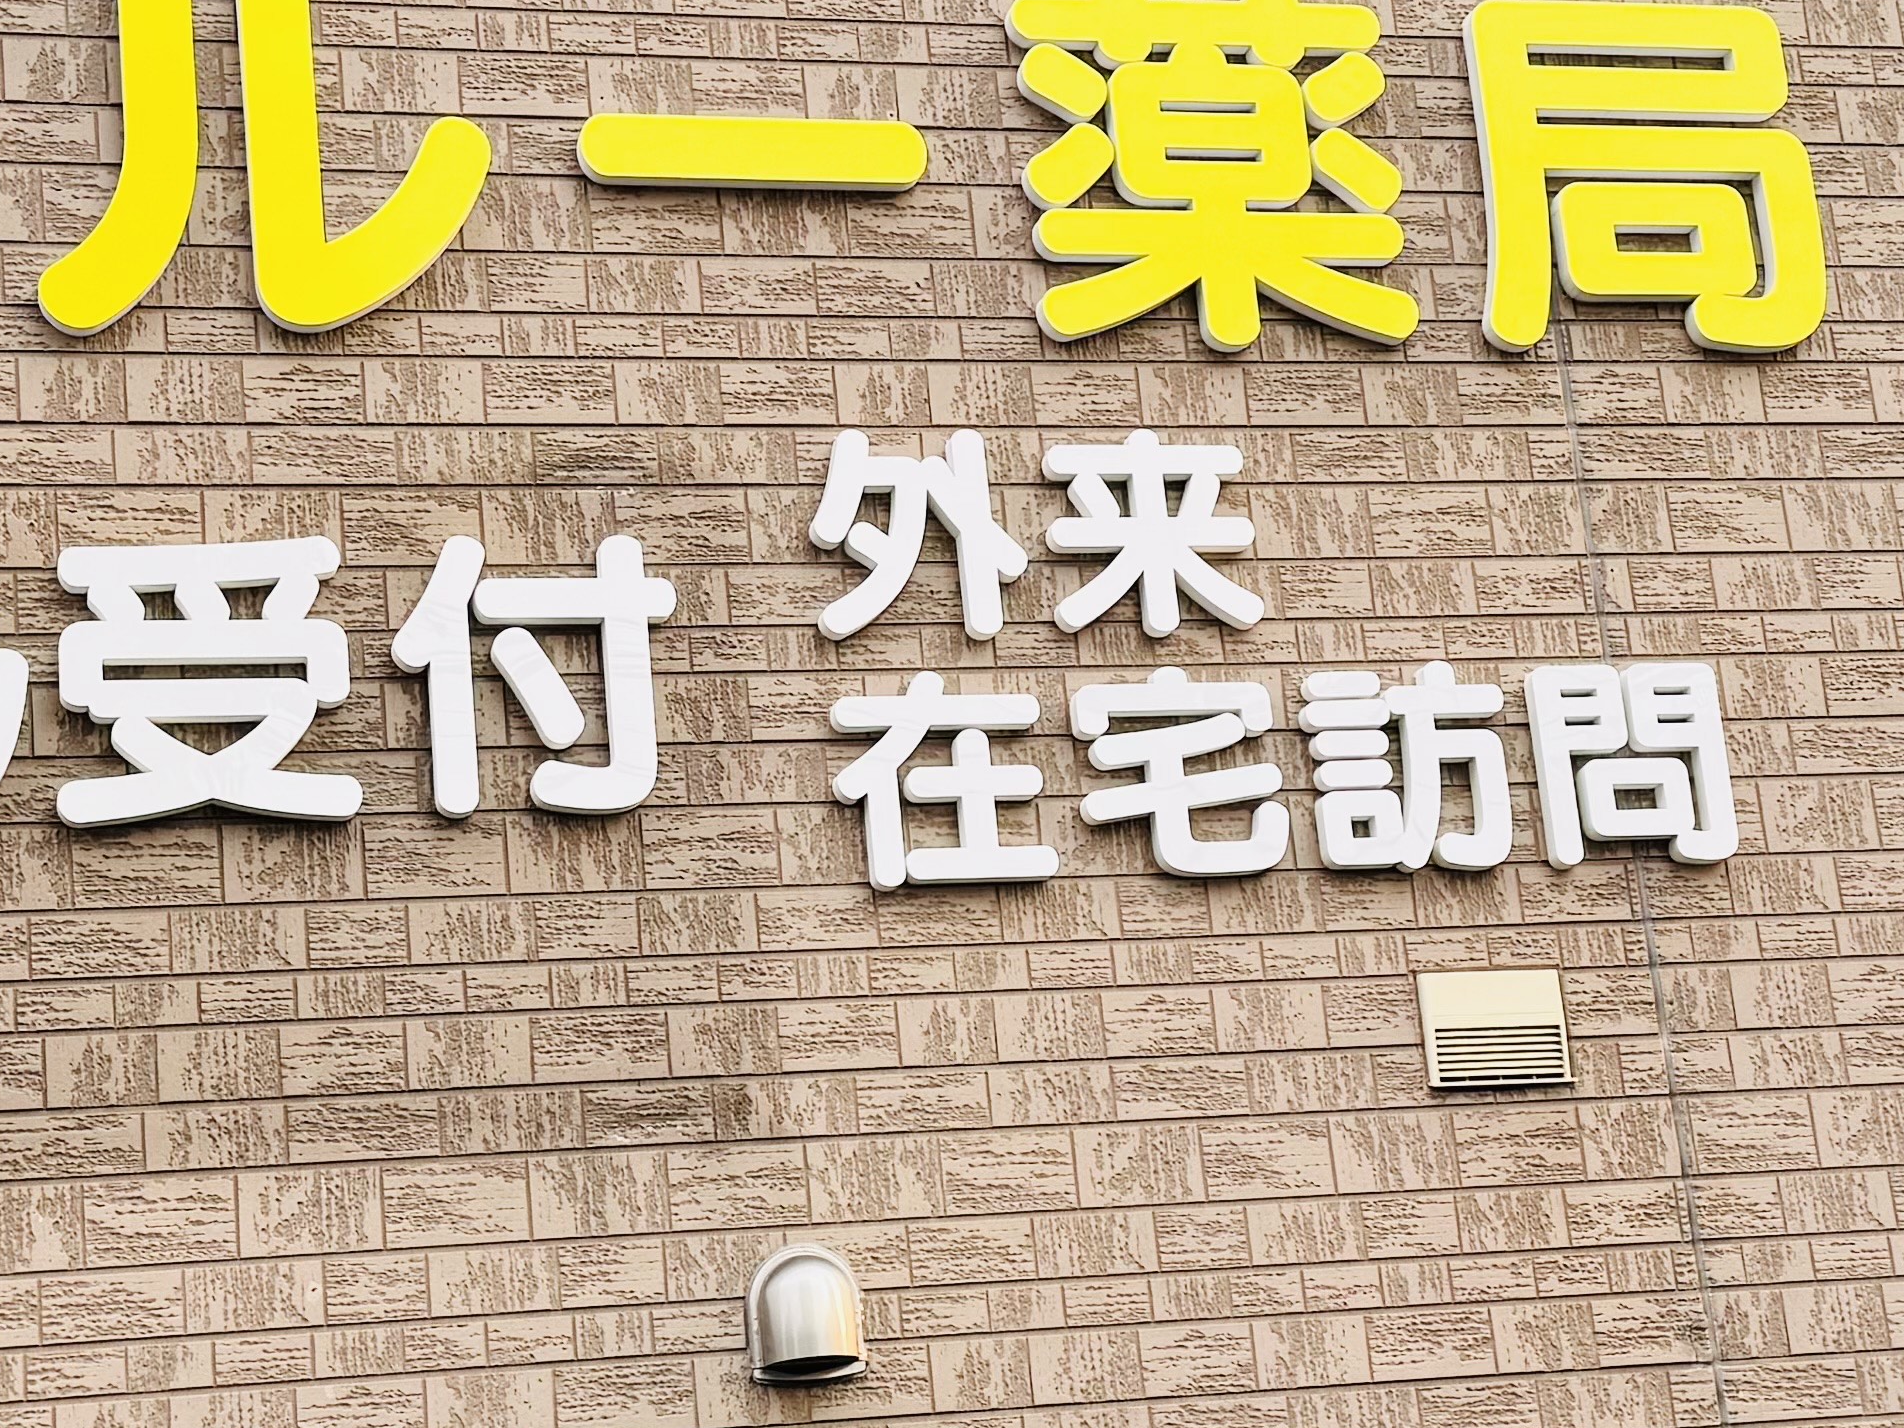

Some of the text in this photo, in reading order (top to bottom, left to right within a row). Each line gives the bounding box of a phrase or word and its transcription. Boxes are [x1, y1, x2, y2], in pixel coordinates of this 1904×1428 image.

[810, 427, 1266, 644] 外来
[828, 661, 1741, 892] 在宅訪問
